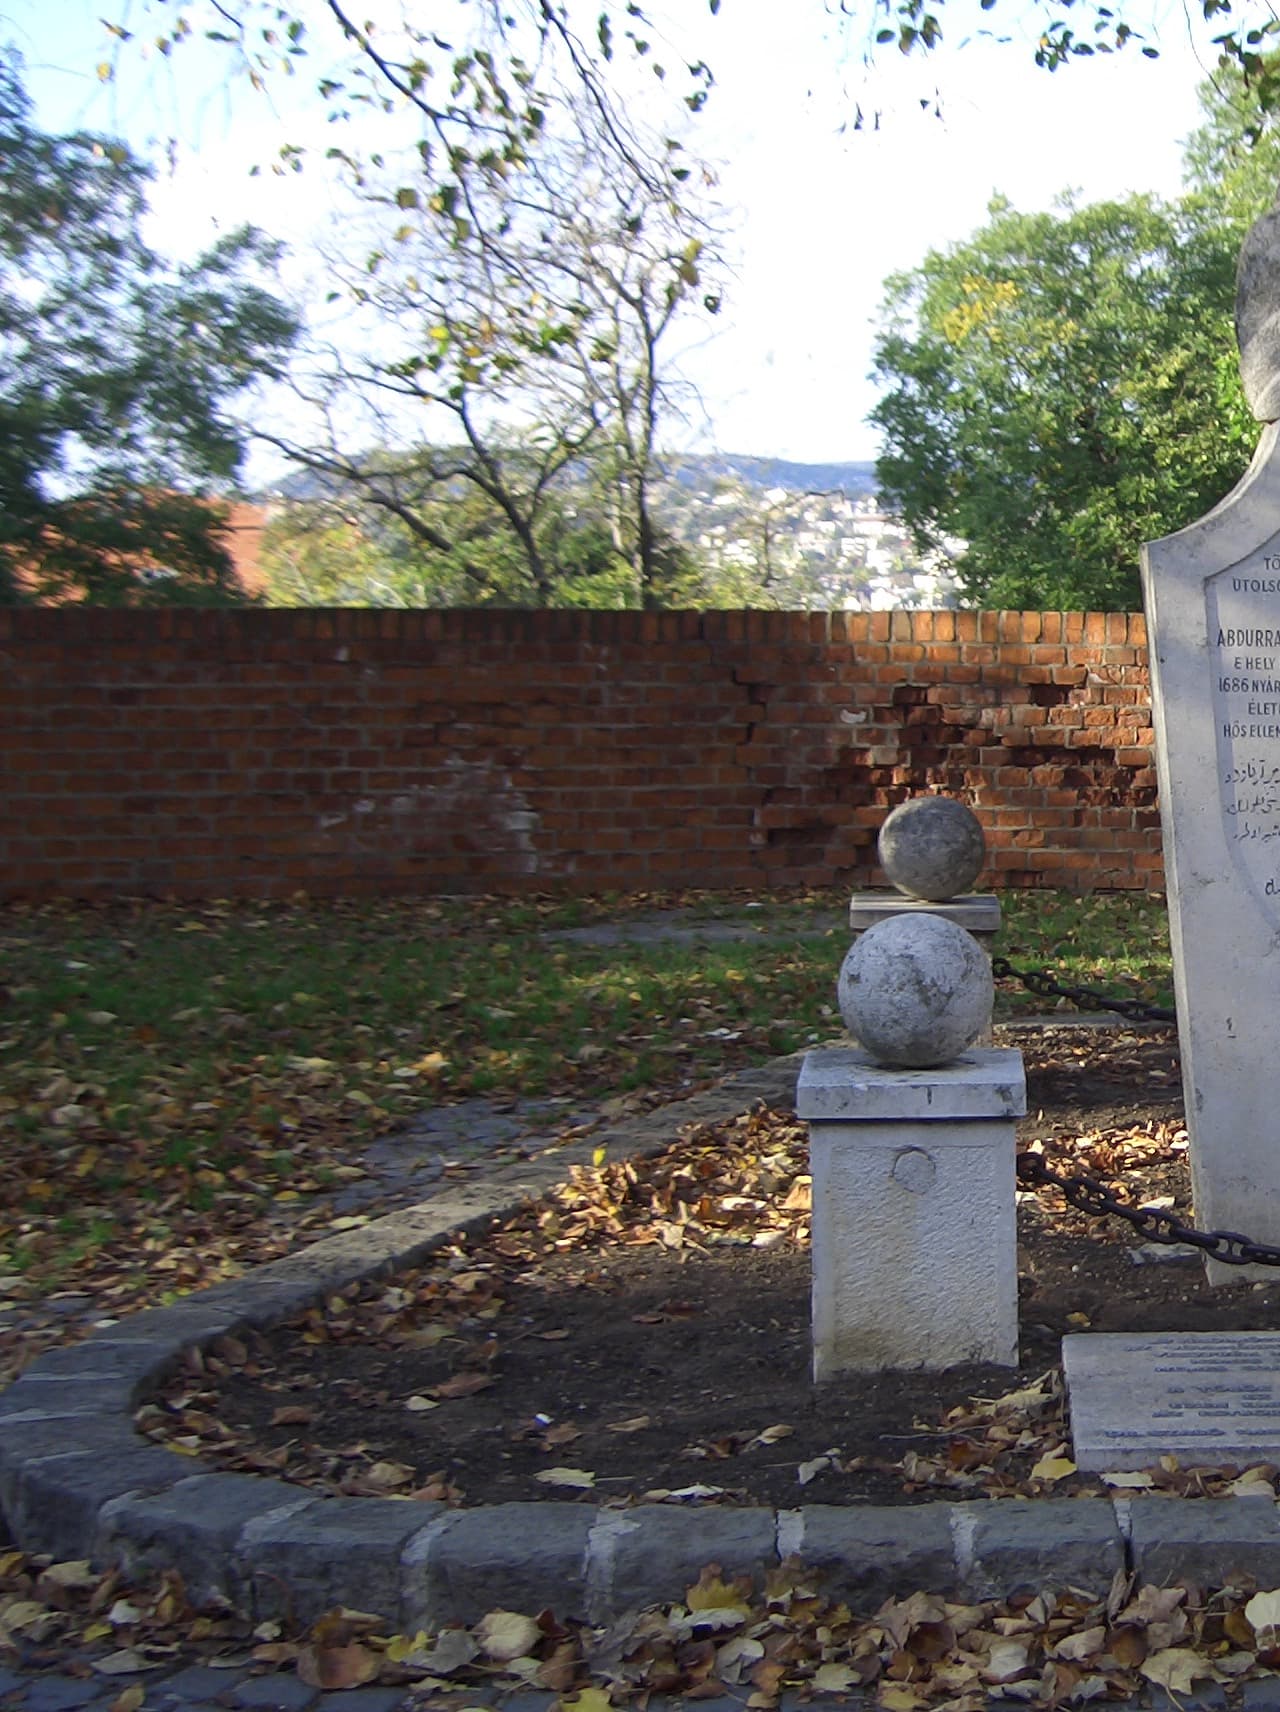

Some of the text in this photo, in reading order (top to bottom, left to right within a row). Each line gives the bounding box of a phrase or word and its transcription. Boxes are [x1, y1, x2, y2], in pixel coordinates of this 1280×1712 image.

[1234, 656, 1242, 670] E
[1245, 656, 1275, 670] HELY
[1219, 677, 1249, 693] 1686
